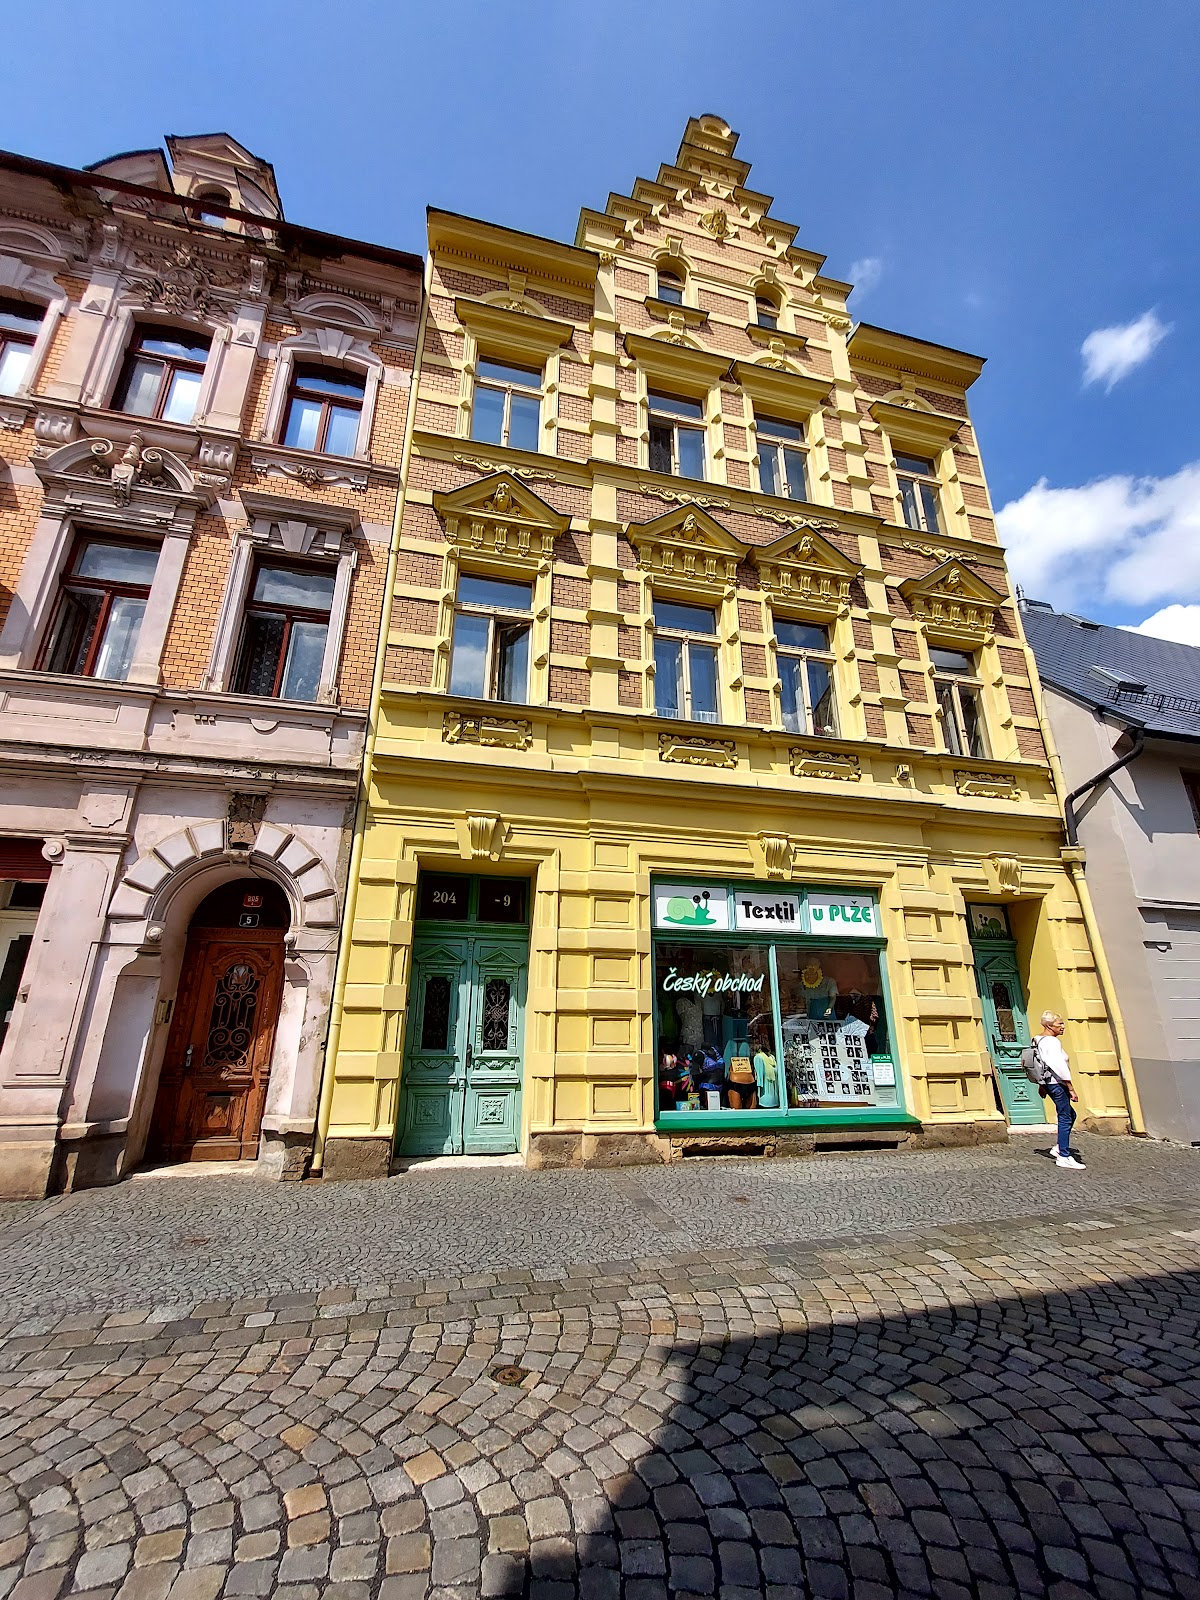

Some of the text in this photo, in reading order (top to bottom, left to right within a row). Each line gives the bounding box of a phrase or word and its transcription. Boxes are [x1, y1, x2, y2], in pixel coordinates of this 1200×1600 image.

[433, 891, 456, 904] 204
[742, 901, 872, 923] Textil u PLŽE
[663, 967, 765, 998] Český obchod
